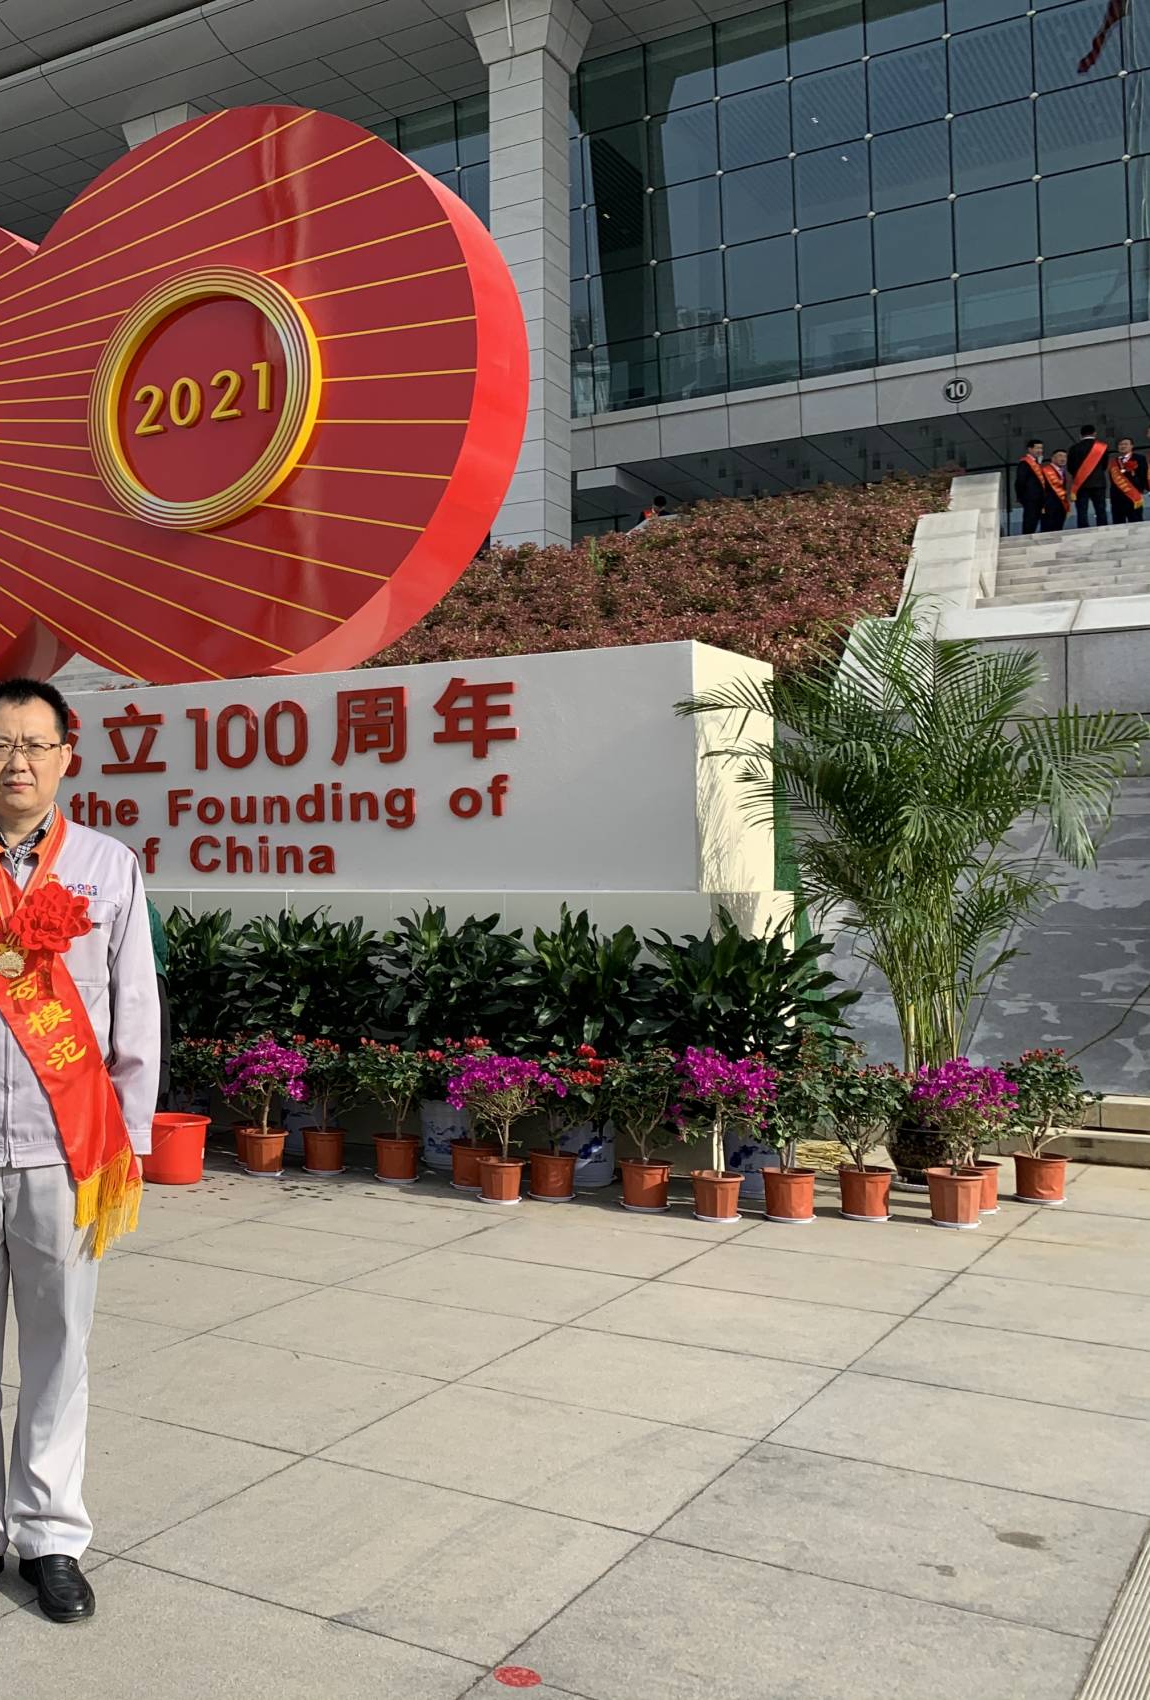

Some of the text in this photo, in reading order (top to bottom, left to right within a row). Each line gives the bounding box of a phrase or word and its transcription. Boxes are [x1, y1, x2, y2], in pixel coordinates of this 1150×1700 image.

[134, 361, 273, 436] 2021
[947, 382, 968, 399] 10
[70, 791, 139, 827] the
[167, 782, 417, 829] Founding
[448, 773, 511, 819] of
[189, 834, 336, 875] China
